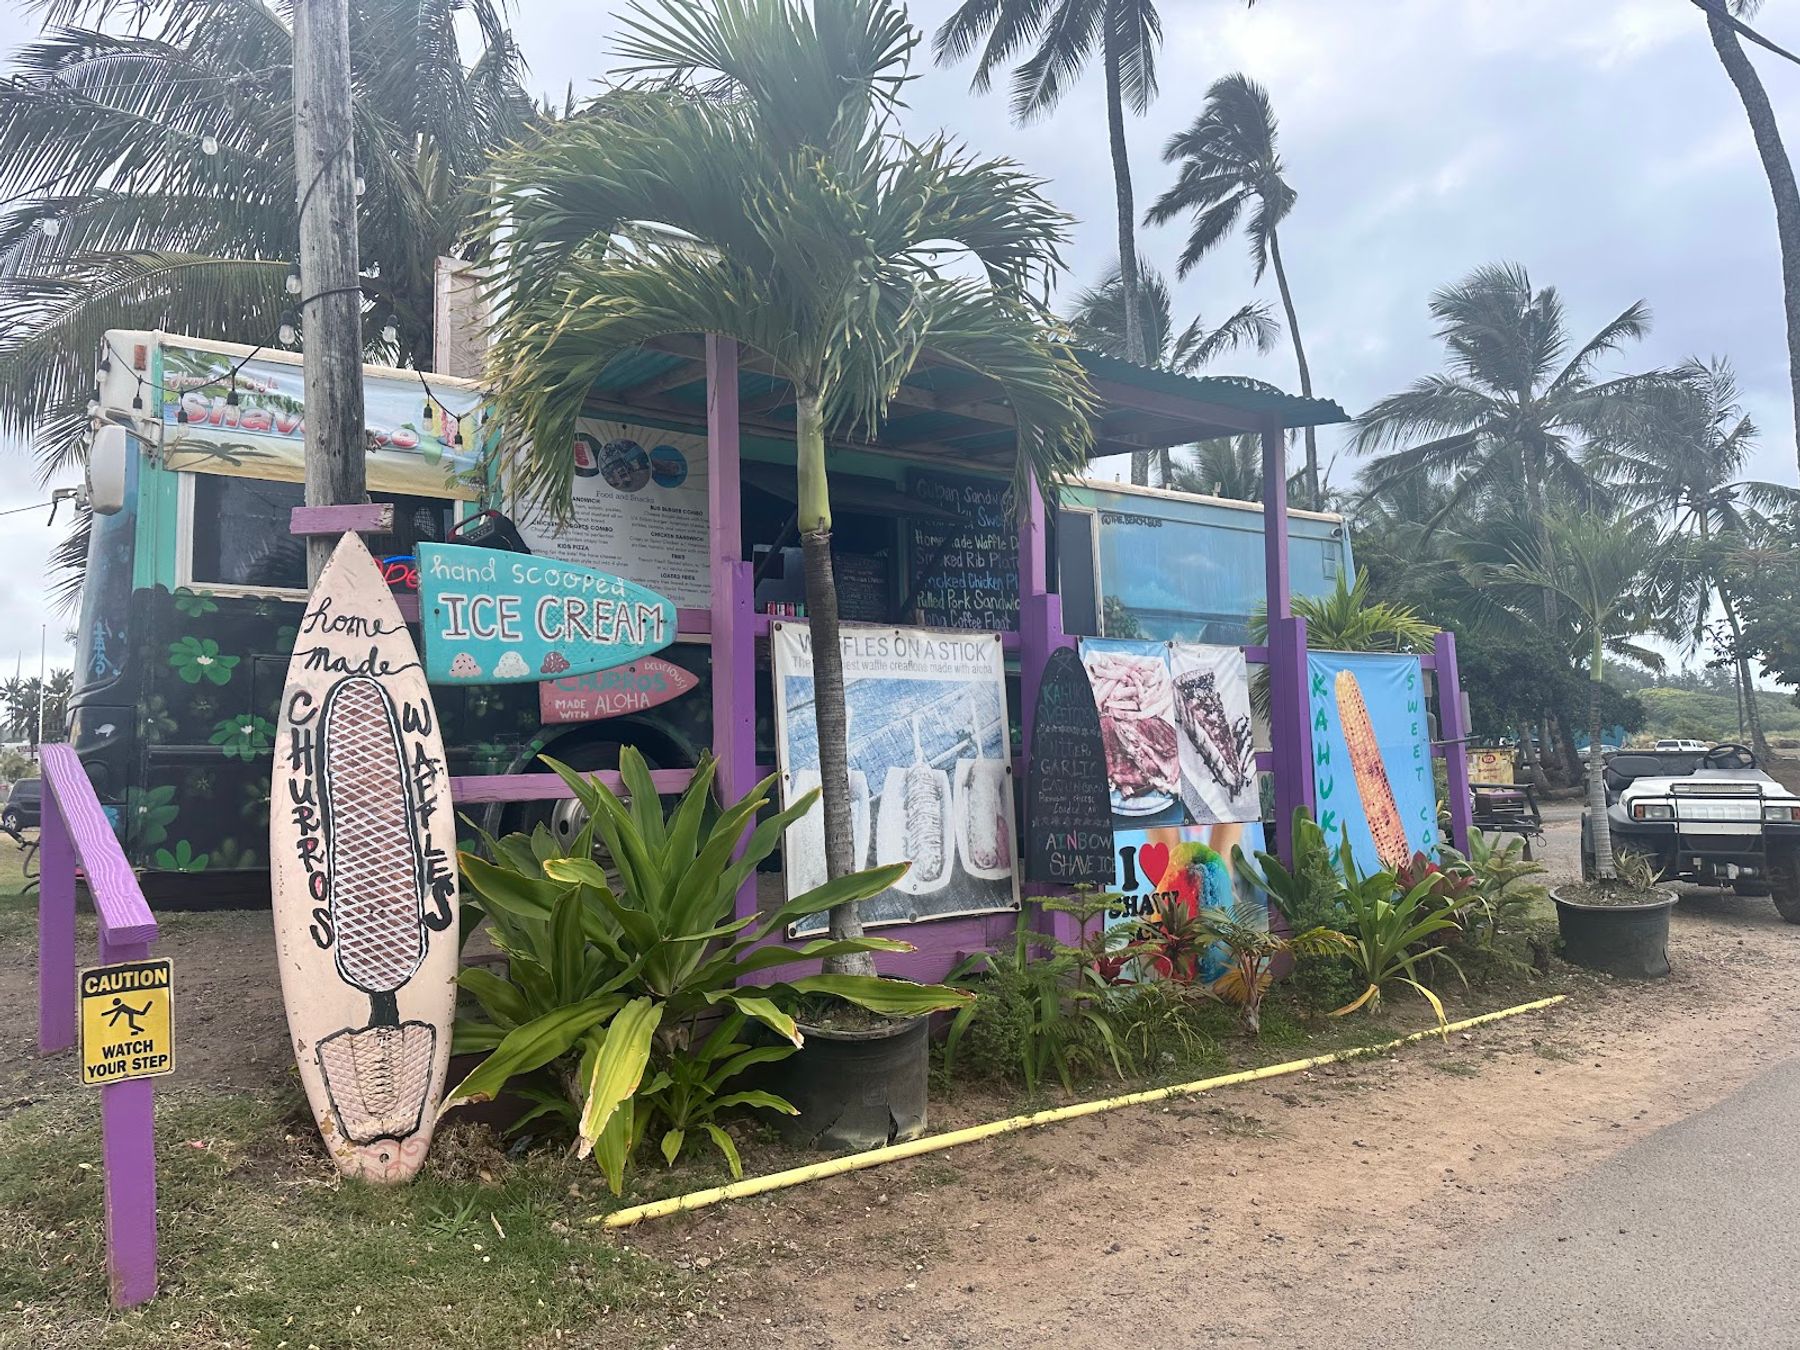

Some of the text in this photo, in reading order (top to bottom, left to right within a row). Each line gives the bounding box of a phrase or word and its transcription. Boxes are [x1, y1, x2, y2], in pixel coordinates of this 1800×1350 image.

[177, 391, 310, 438] Shav
[572, 496, 601, 504] ANDWICH
[974, 534, 1007, 550] Waffle
[916, 547, 963, 568] Smked
[966, 553, 986, 568] Rib
[430, 554, 627, 597] hand scooped
[968, 571, 1003, 590] Chicken
[917, 588, 1021, 611] Pulled Pork Sandwic
[304, 597, 410, 638] home
[439, 592, 665, 645] ICE CREAM
[950, 610, 982, 629] Coffee
[985, 611, 1011, 630] Float
[798, 634, 987, 662] WFLES ON A STICK
[293, 646, 421, 678] made
[930, 662, 953, 674] made
[555, 672, 668, 693] CHURROS
[644, 661, 688, 690] DELICIOUS!
[555, 698, 587, 710] MADE
[560, 710, 590, 720] WITH
[594, 692, 650, 716] ALOHA
[1406, 673, 1424, 782] SWEET
[1040, 758, 1098, 778] GARLIC
[287, 690, 335, 950] CHURROS
[403, 698, 455, 932] WAFFLES
[1049, 851, 1116, 878] SHAVE ICE
[1118, 846, 1140, 892] I
[84, 967, 168, 994] CAUTION
[102, 1039, 154, 1060] WATCH
[87, 1054, 168, 1078] YOUR STEP
